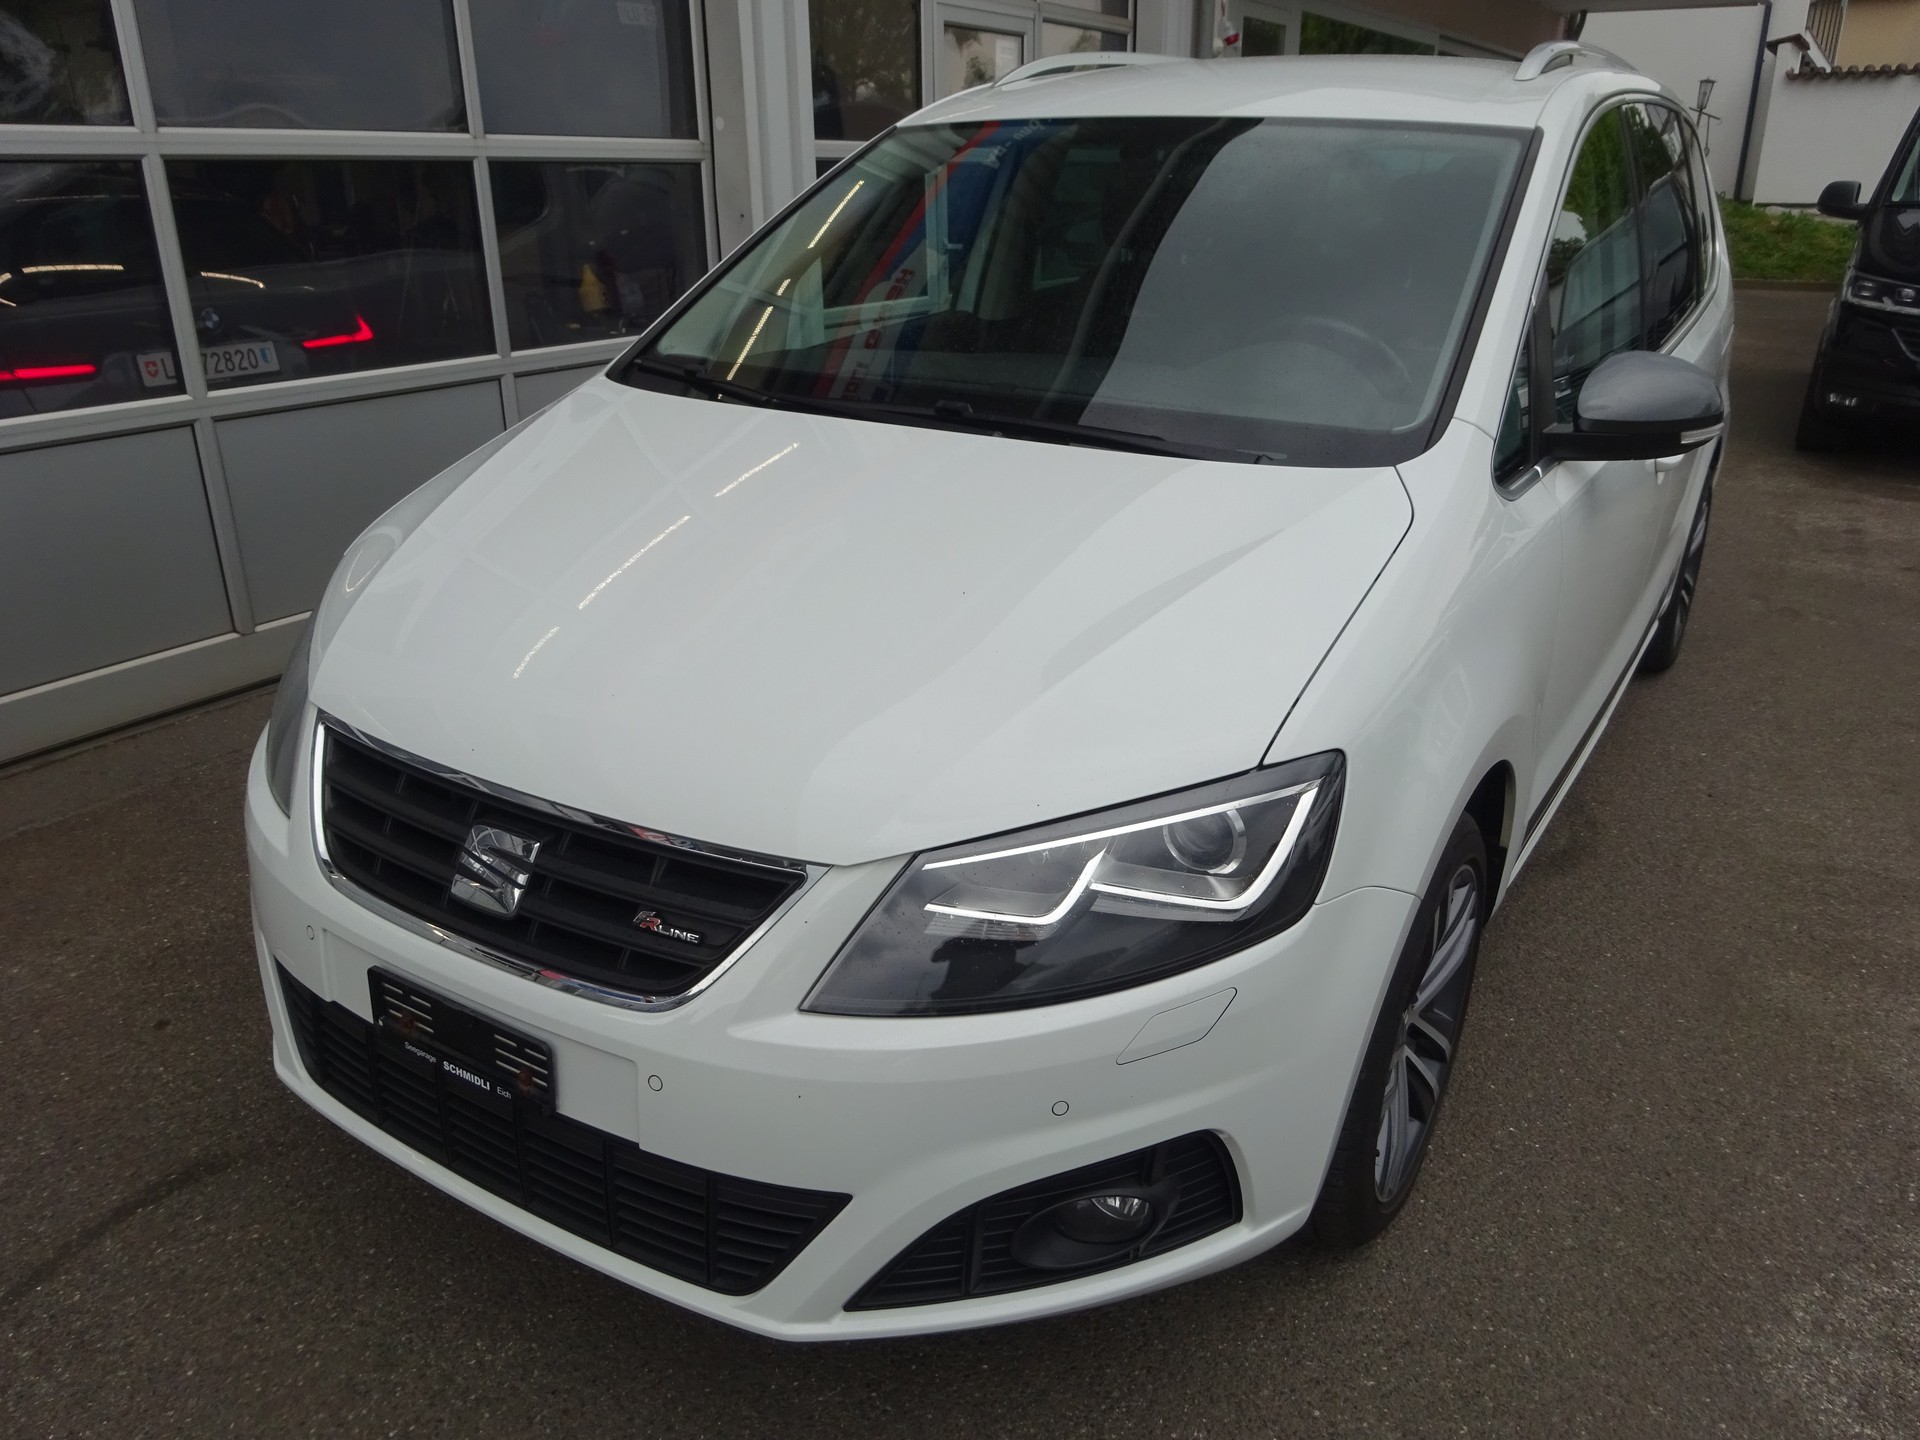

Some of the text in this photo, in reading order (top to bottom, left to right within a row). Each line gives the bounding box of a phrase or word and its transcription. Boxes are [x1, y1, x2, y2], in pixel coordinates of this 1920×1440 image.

[200, 347, 259, 375] 72820
[404, 1041, 512, 1100] Seegarage SCHMIDLI Eich
